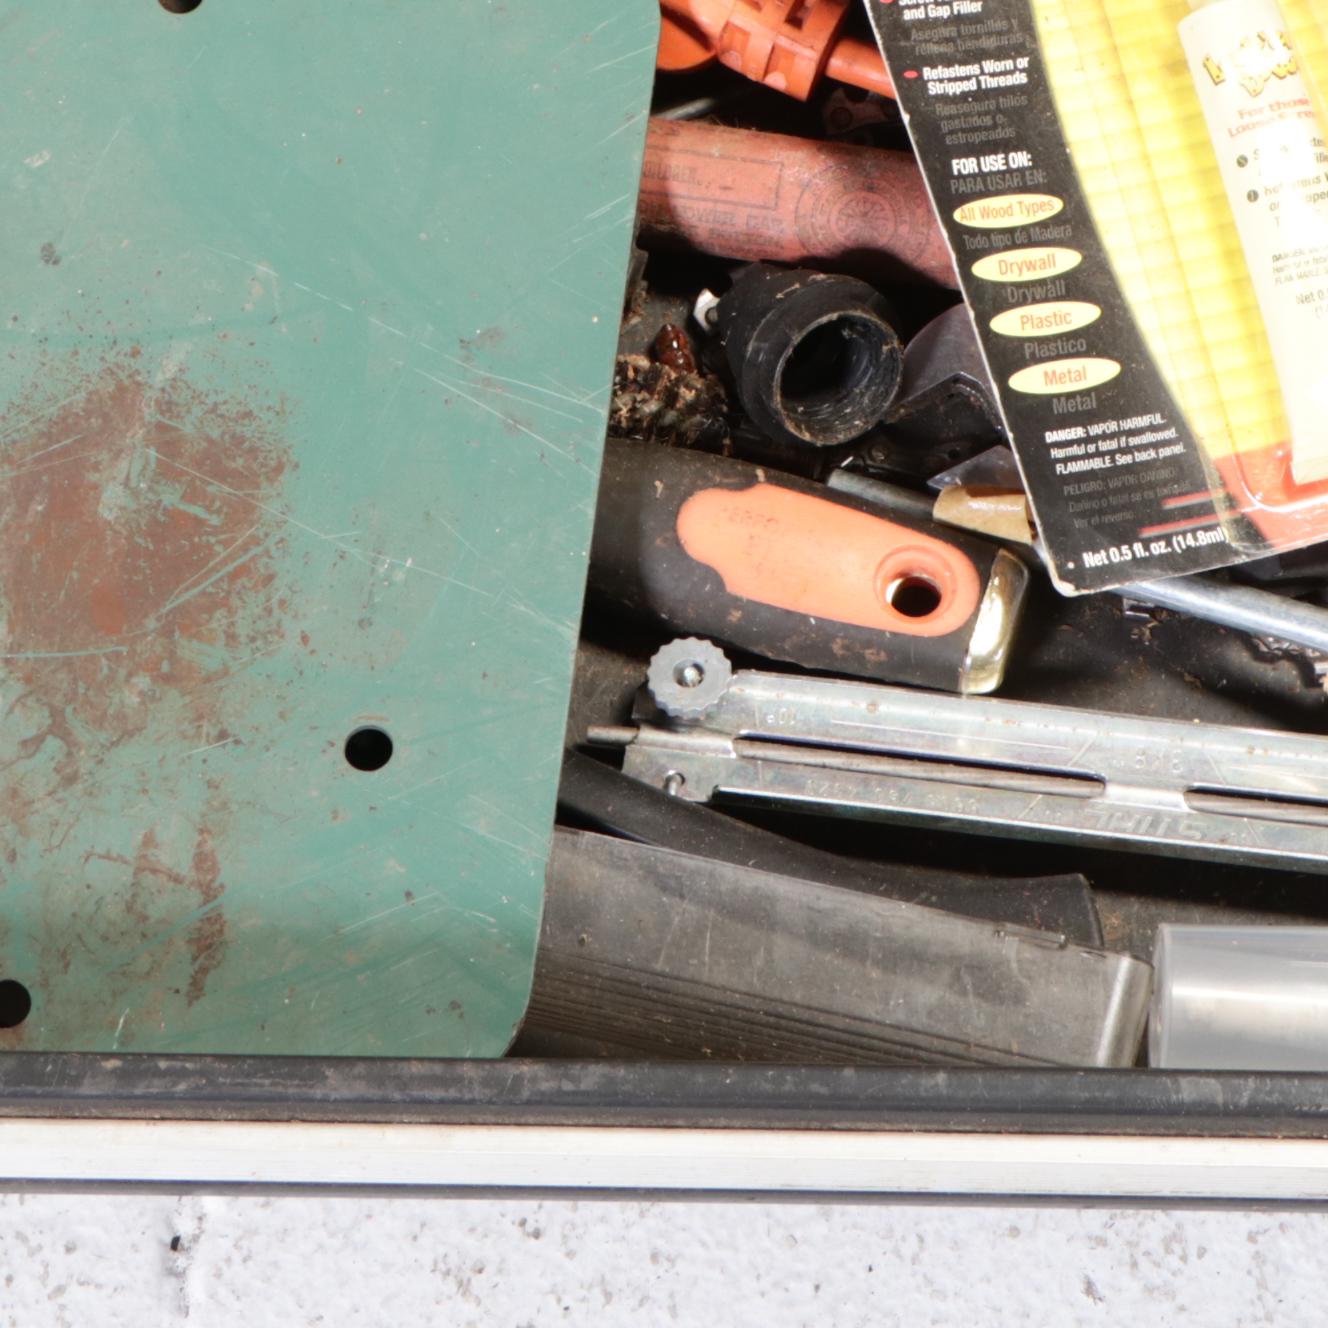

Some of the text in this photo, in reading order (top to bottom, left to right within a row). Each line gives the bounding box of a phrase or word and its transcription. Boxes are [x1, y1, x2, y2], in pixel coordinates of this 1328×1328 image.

[903, 0, 983, 21] and Gap Filler
[923, 56, 1030, 81] Refastens Worn or
[928, 71, 1028, 96] Stripped Threads
[945, 125, 1016, 146] estropeados
[952, 150, 1033, 176] FOR USE ON:
[950, 170, 1047, 195] PARA USAR EN:
[959, 198, 1055, 222] All Wood Types
[963, 223, 1073, 251] Todo tipo de Madera
[998, 253, 1057, 277] Drywall
[1007, 279, 1066, 304] Drywall
[1020, 308, 1073, 331] Plastic
[1024, 337, 1088, 360] Plastico
[1043, 365, 1088, 387] Metal
[1053, 392, 1097, 415] Metal
[1045, 413, 1168, 444] DANGER: VAPOR HARMFUL.
[1051, 427, 1178, 459] Harmful or fatal if swallowed.
[1056, 442, 1187, 475] FLAMMABLE. See back panel.
[1063, 479, 1107, 496] PELIGRO:
[1082, 526, 1229, 569] Net 0.5 fl. oz. (14.8ml)
[1086, 805, 1203, 842] STIHL
